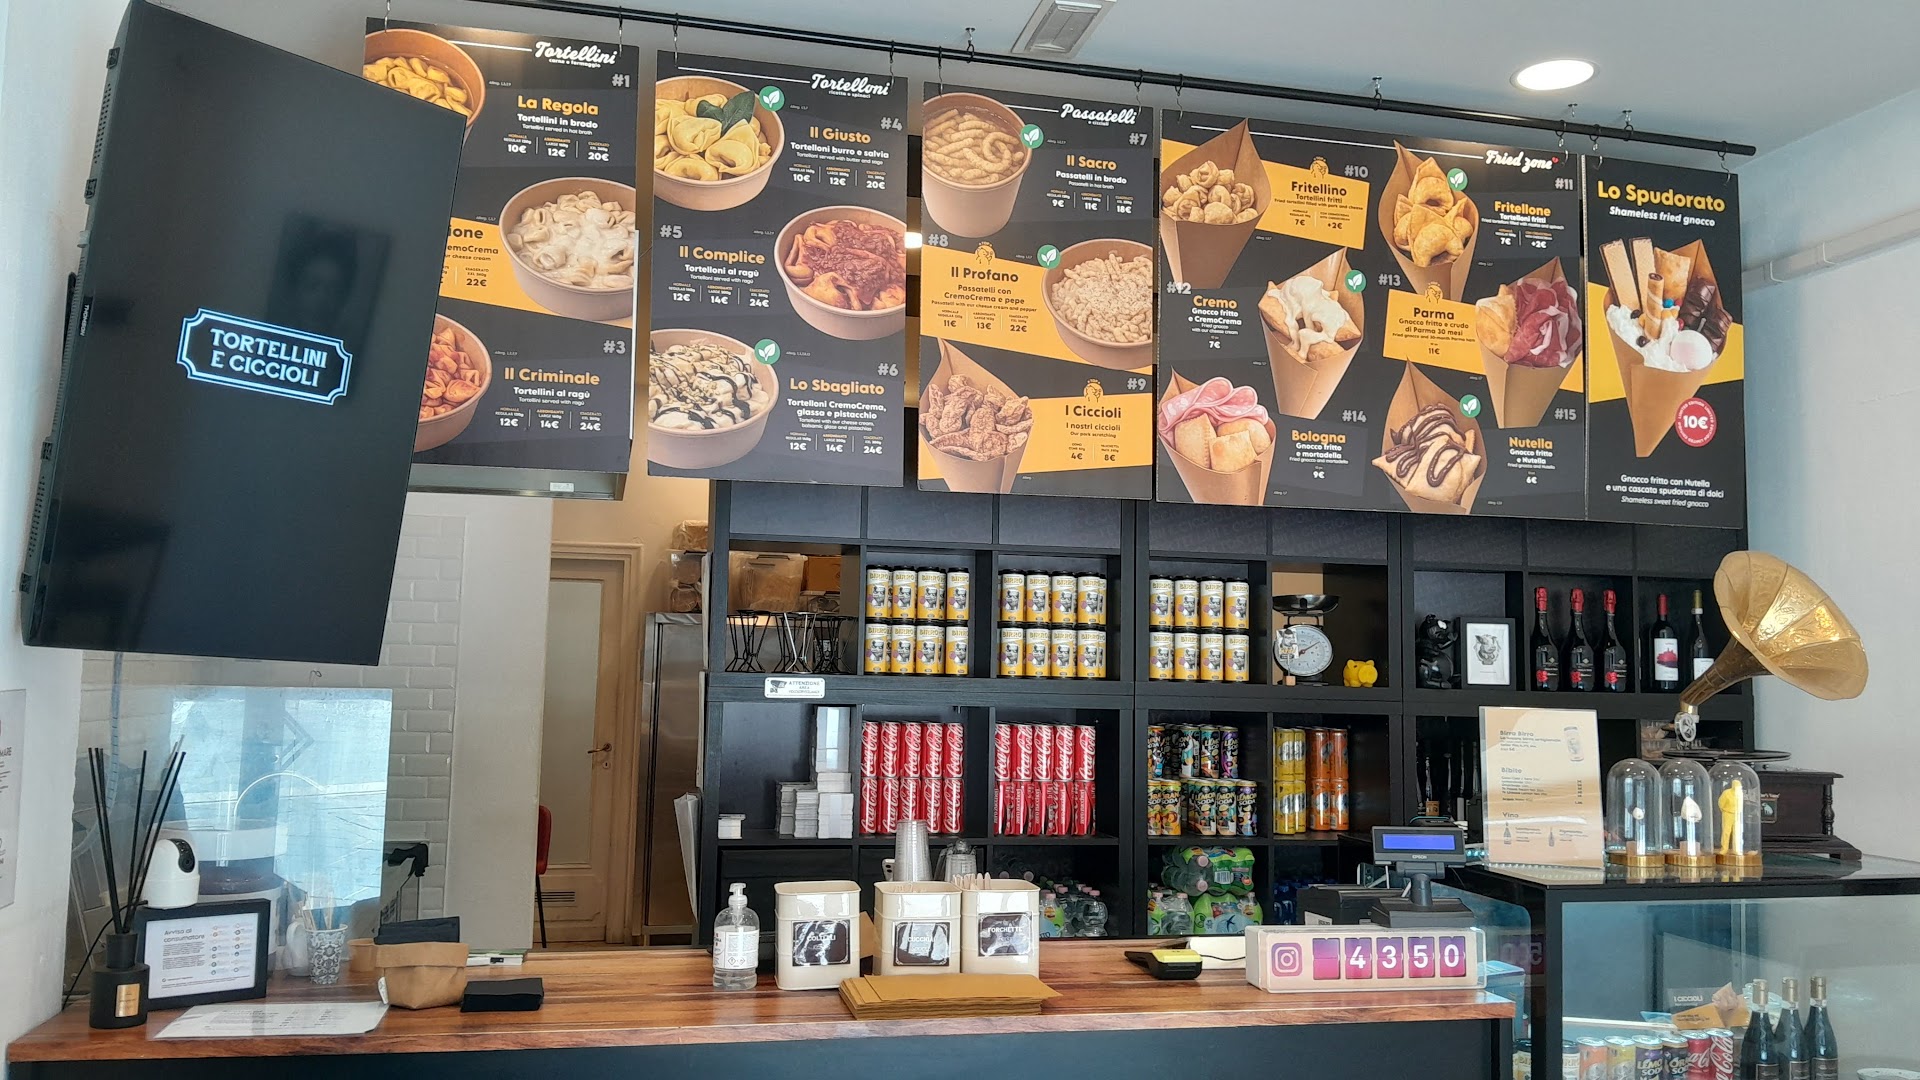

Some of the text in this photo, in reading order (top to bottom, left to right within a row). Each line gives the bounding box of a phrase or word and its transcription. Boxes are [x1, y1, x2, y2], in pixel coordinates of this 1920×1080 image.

[535, 42, 617, 64] Tortellini
[612, 74, 630, 87] #1
[812, 74, 890, 95] Tortelloni
[518, 95, 598, 115] La Regola
[1060, 103, 1137, 124] Passatelli
[517, 114, 598, 129] Tortellini in brodo
[881, 117, 902, 131] #4
[810, 126, 871, 143] Il Giusto
[1129, 132, 1147, 146] #7
[508, 144, 526, 154] 10€
[548, 148, 566, 157] 12€
[790, 142, 830, 153] Tortelloni
[832, 146, 855, 155] burro
[864, 149, 889, 158] salvia
[588, 152, 609, 161] 20€
[1067, 155, 1116, 170] Il Sacro
[1486, 150, 1552, 173] Fried zone
[793, 174, 810, 182] 10€
[1056, 171, 1093, 180] Passatelli
[1104, 175, 1127, 184] brodo
[1344, 165, 1368, 178] #10
[830, 177, 846, 185] 12€
[866, 181, 885, 189] 20€
[1555, 178, 1573, 190] #11
[1292, 181, 1347, 196] Fritellino
[1598, 181, 1725, 212] Lo Spudorato
[1494, 201, 1551, 216] Fritellone
[1610, 206, 1715, 226] Shameless fried gnocco
[660, 224, 682, 238] #5
[928, 234, 948, 247] #8
[680, 246, 765, 264] Il Complice
[685, 264, 726, 274] Tortelloni
[738, 270, 759, 278] ragù
[951, 267, 1018, 282] Il Profano
[1378, 274, 1401, 286] #13
[958, 285, 995, 293] Passatelli
[1167, 281, 1191, 294] #12
[673, 293, 690, 301] 12€
[711, 296, 728, 304] 14€
[750, 299, 769, 307] 24€
[944, 292, 996, 302] CremoCrema
[1193, 295, 1237, 309] Cremo
[1192, 308, 1219, 316] Gnocco
[1414, 308, 1454, 320] Parma
[210, 328, 327, 368] TORTELLINI
[603, 340, 625, 354] #3
[211, 350, 319, 387] E CICCIOLI
[878, 363, 898, 376] #6
[505, 368, 600, 385] Il Criminale
[790, 378, 884, 396] Lo Sbagliato
[1127, 378, 1146, 390] #9
[514, 387, 590, 399] Tortellini al ragù
[787, 399, 886, 412] Tortelloni CremoCrema,
[1065, 405, 1121, 418] I Ciccioli
[797, 408, 825, 417] glassa
[834, 410, 877, 419] pistacchio
[1342, 410, 1366, 422] #14
[1554, 408, 1576, 420] #15
[500, 418, 518, 426] 12€
[540, 421, 559, 429] 14€
[580, 423, 601, 431] 24€
[1683, 415, 1708, 429] 10€
[1292, 430, 1346, 445] Bologna
[1509, 437, 1552, 449] Nutella
[864, 446, 882, 454] 24€
[1621, 475, 1649, 484] Gnocco
[1650, 476, 1668, 485] fritto
[1685, 479, 1710, 487] Nutella
[1629, 486, 1657, 494] cascata
[1659, 488, 1696, 496] spudorata
[1707, 490, 1724, 498] dolci
[1621, 496, 1653, 504] Shameless
[861, 722, 878, 777] Coca-Cola
[880, 722, 897, 777] Coca-Cola
[904, 723, 921, 777] Coca-Cola
[926, 723, 942, 777] Coca-Cola
[1350, 944, 1459, 969] 4350
